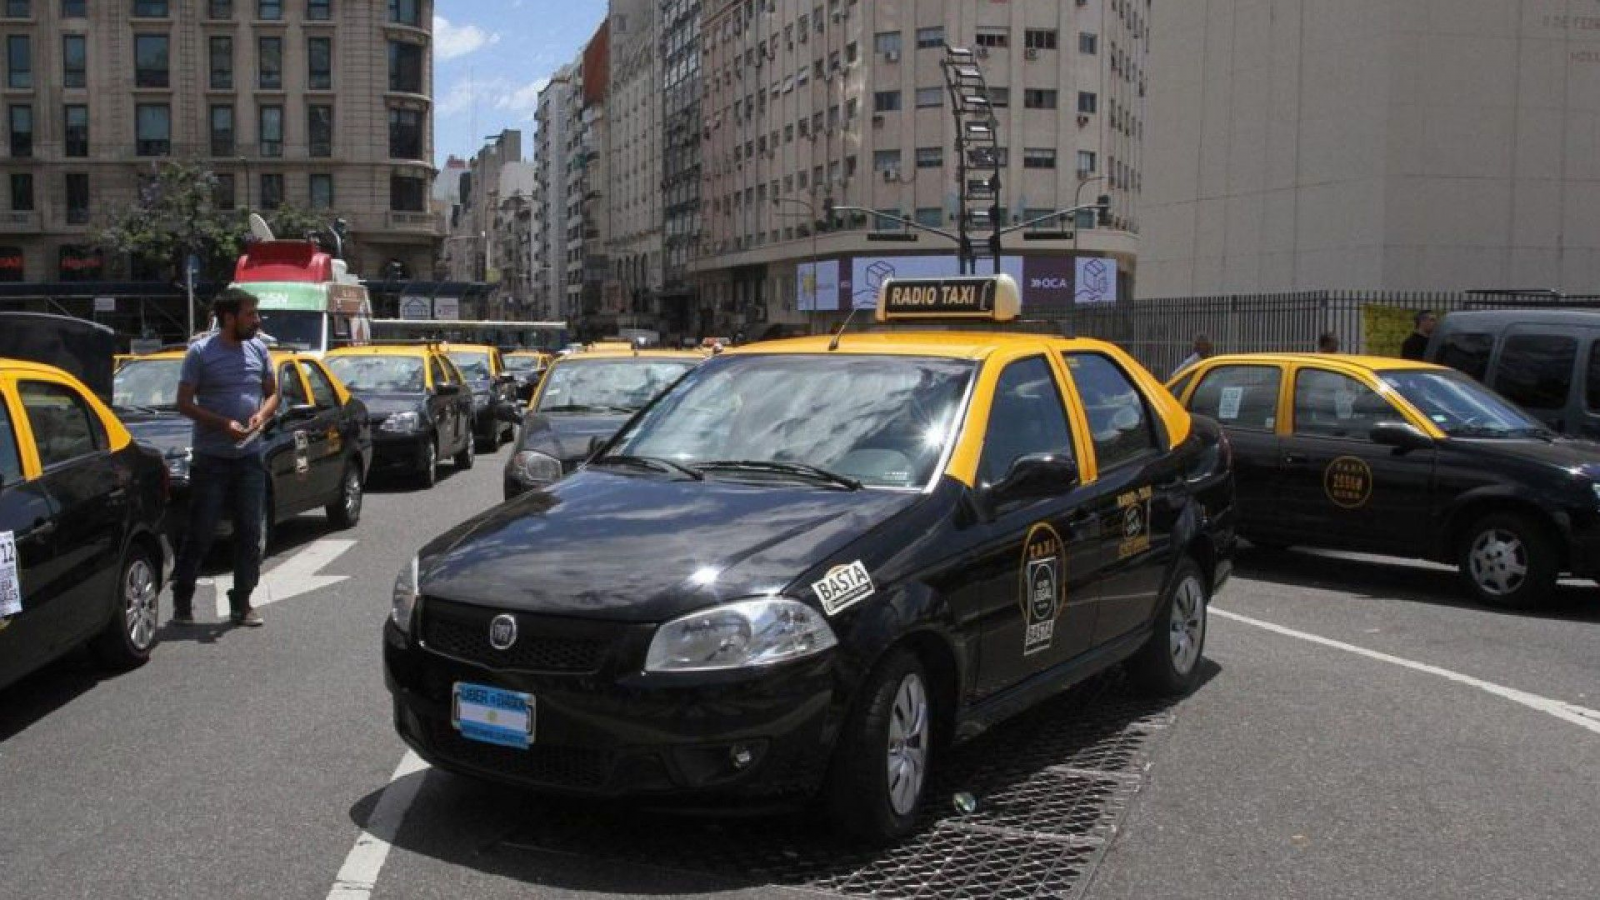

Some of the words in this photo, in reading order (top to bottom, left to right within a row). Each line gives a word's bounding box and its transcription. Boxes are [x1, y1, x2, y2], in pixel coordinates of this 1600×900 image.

[1043, 277, 1067, 289] OCA
[891, 286, 937, 305] RADIO
[942, 284, 976, 305] TAXI
[817, 565, 867, 601] BASTA
